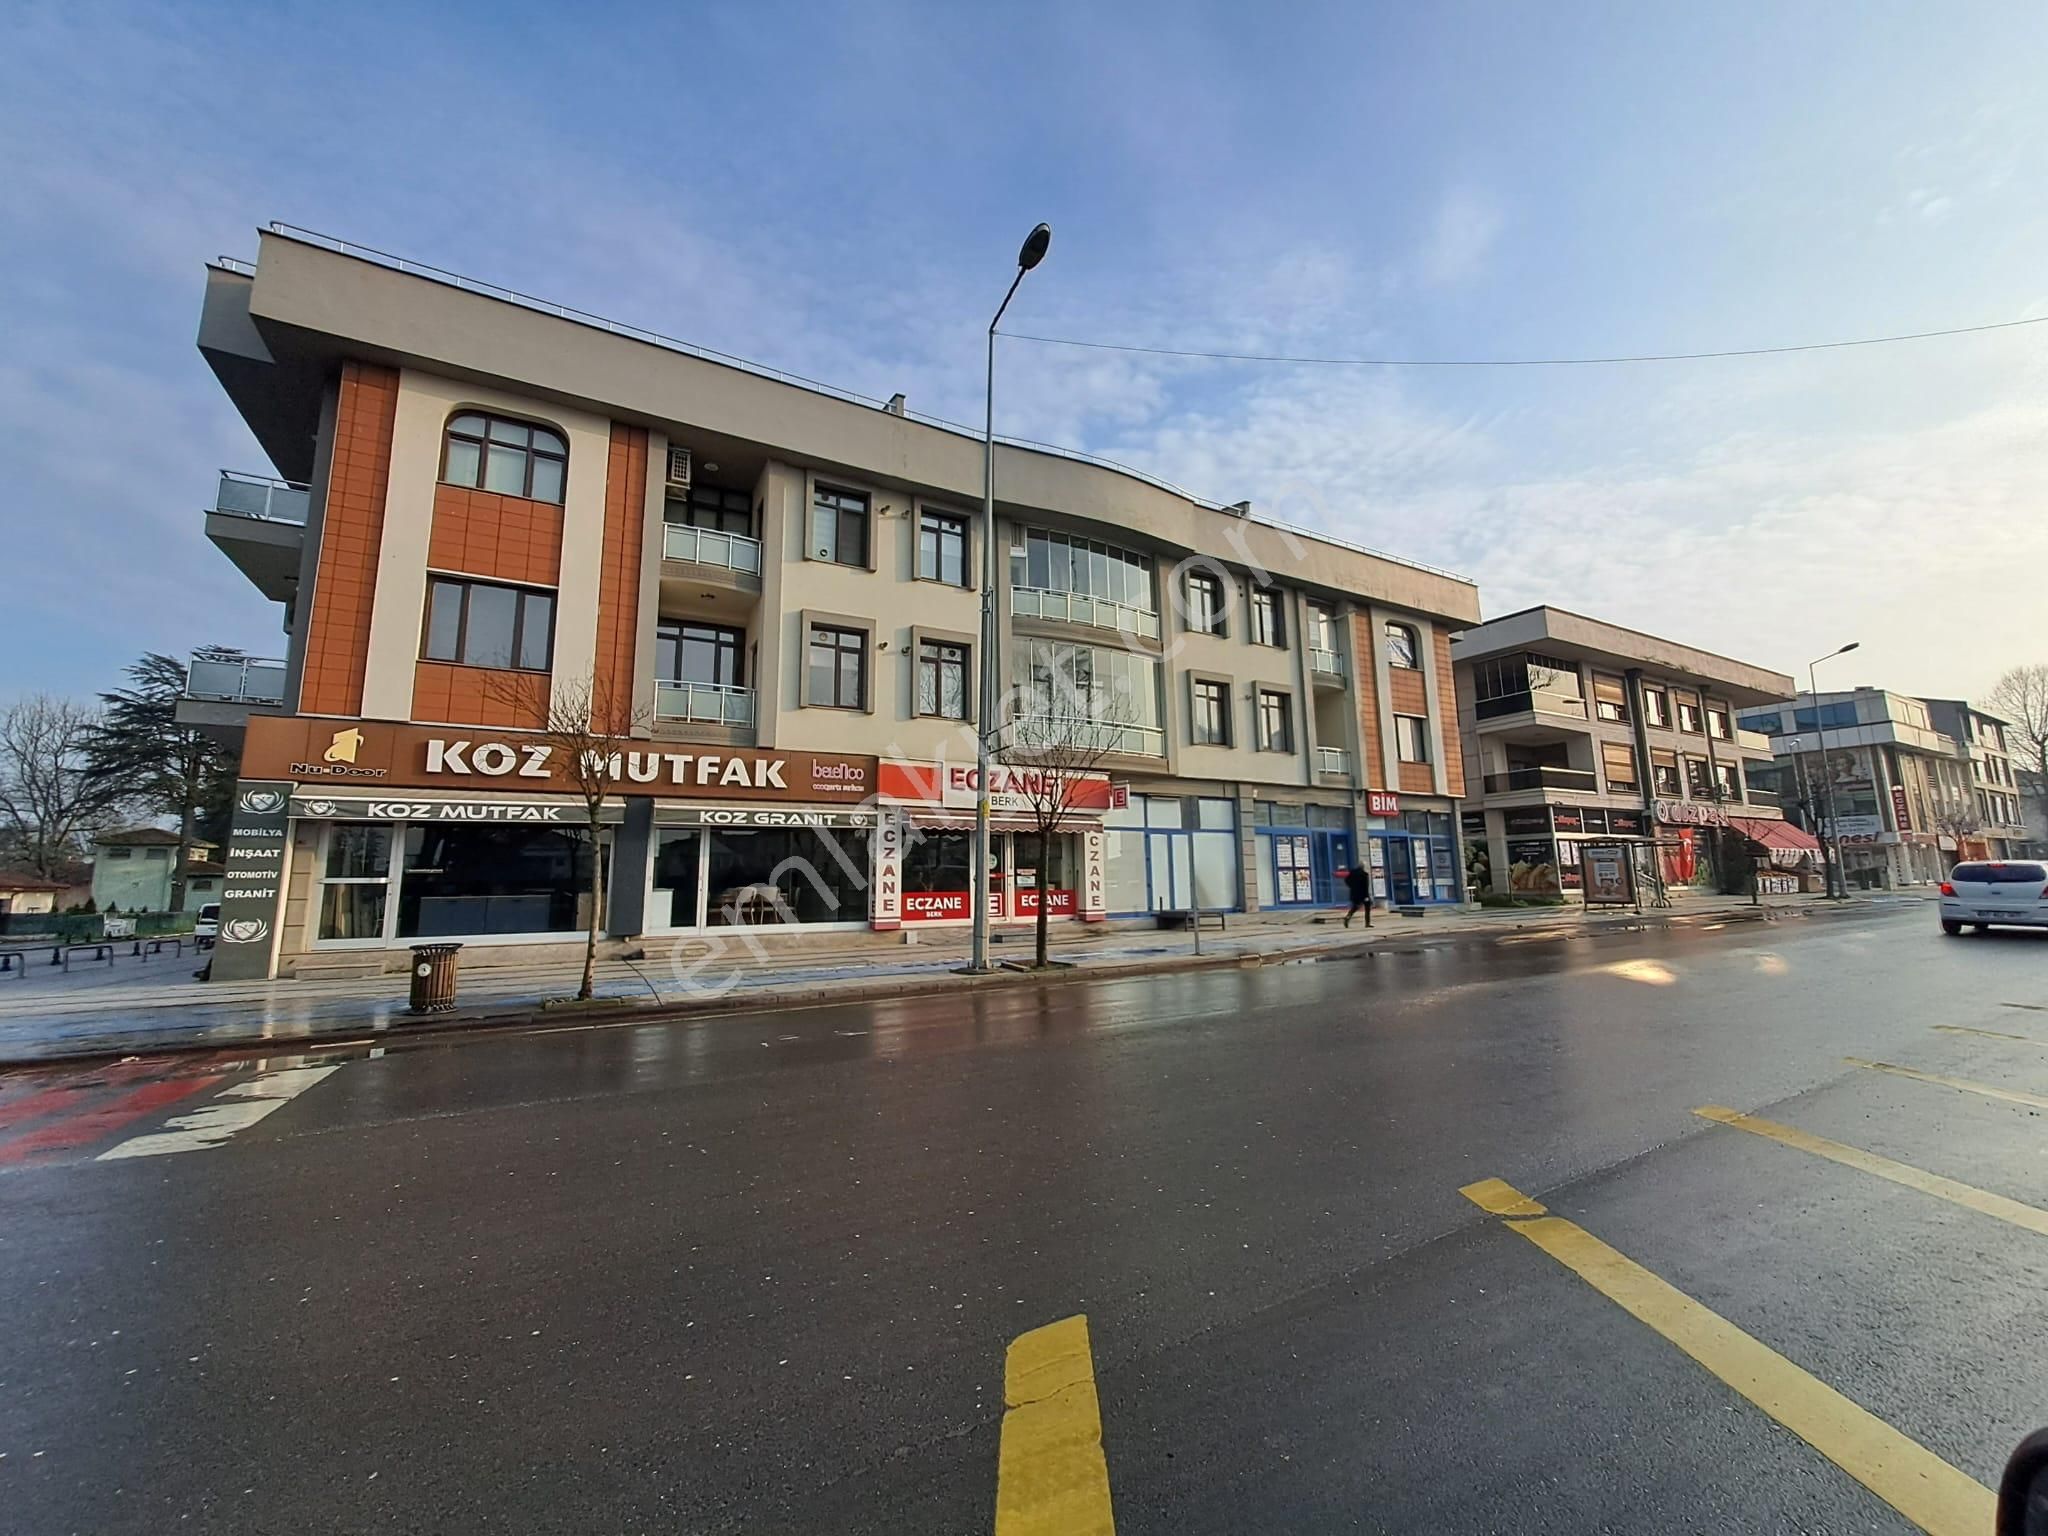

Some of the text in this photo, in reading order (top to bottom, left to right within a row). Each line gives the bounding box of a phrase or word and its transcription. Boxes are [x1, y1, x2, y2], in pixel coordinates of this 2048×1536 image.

[290, 762, 387, 777] Nu-Door
[426, 739, 789, 789] KOZ MUTFAK
[950, 767, 1055, 795] ECZANE
[991, 796, 1020, 807] BERK
[1371, 793, 1397, 811] BİM
[368, 802, 561, 821] KOZ MUTFAK
[699, 810, 748, 824] KOZ
[232, 827, 284, 838] MOBİLYA
[229, 847, 281, 860] İNŞAAT
[882, 812, 896, 912] ECZANE
[226, 870, 279, 880] OTOMOTİV
[1089, 833, 1101, 907] CZANE
[224, 887, 276, 899] GRANİT
[1021, 894, 1069, 907] ECANE
[906, 896, 963, 911] ECZANE
